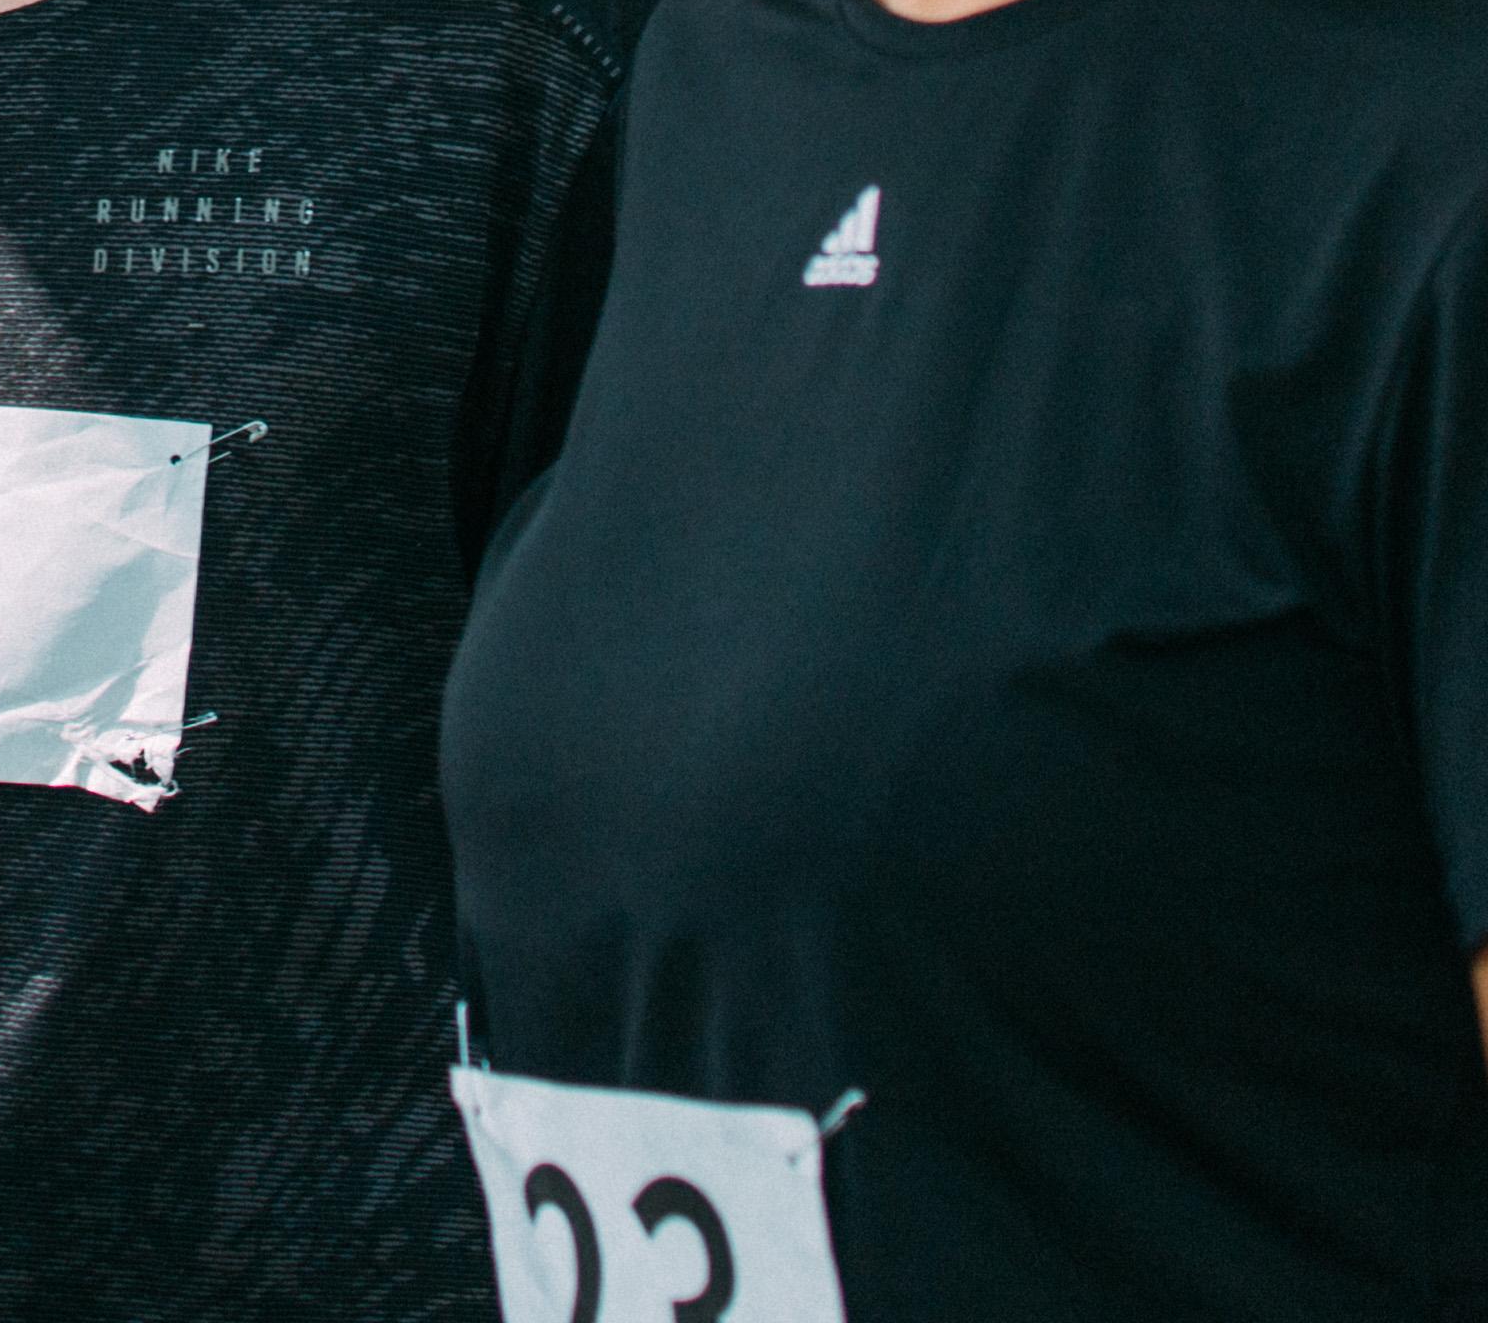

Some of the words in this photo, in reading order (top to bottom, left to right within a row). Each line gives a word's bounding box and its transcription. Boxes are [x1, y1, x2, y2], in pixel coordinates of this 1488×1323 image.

[157, 148, 263, 173] NIKE
[96, 196, 315, 225] RUNNING
[92, 247, 311, 276] DIVISION
